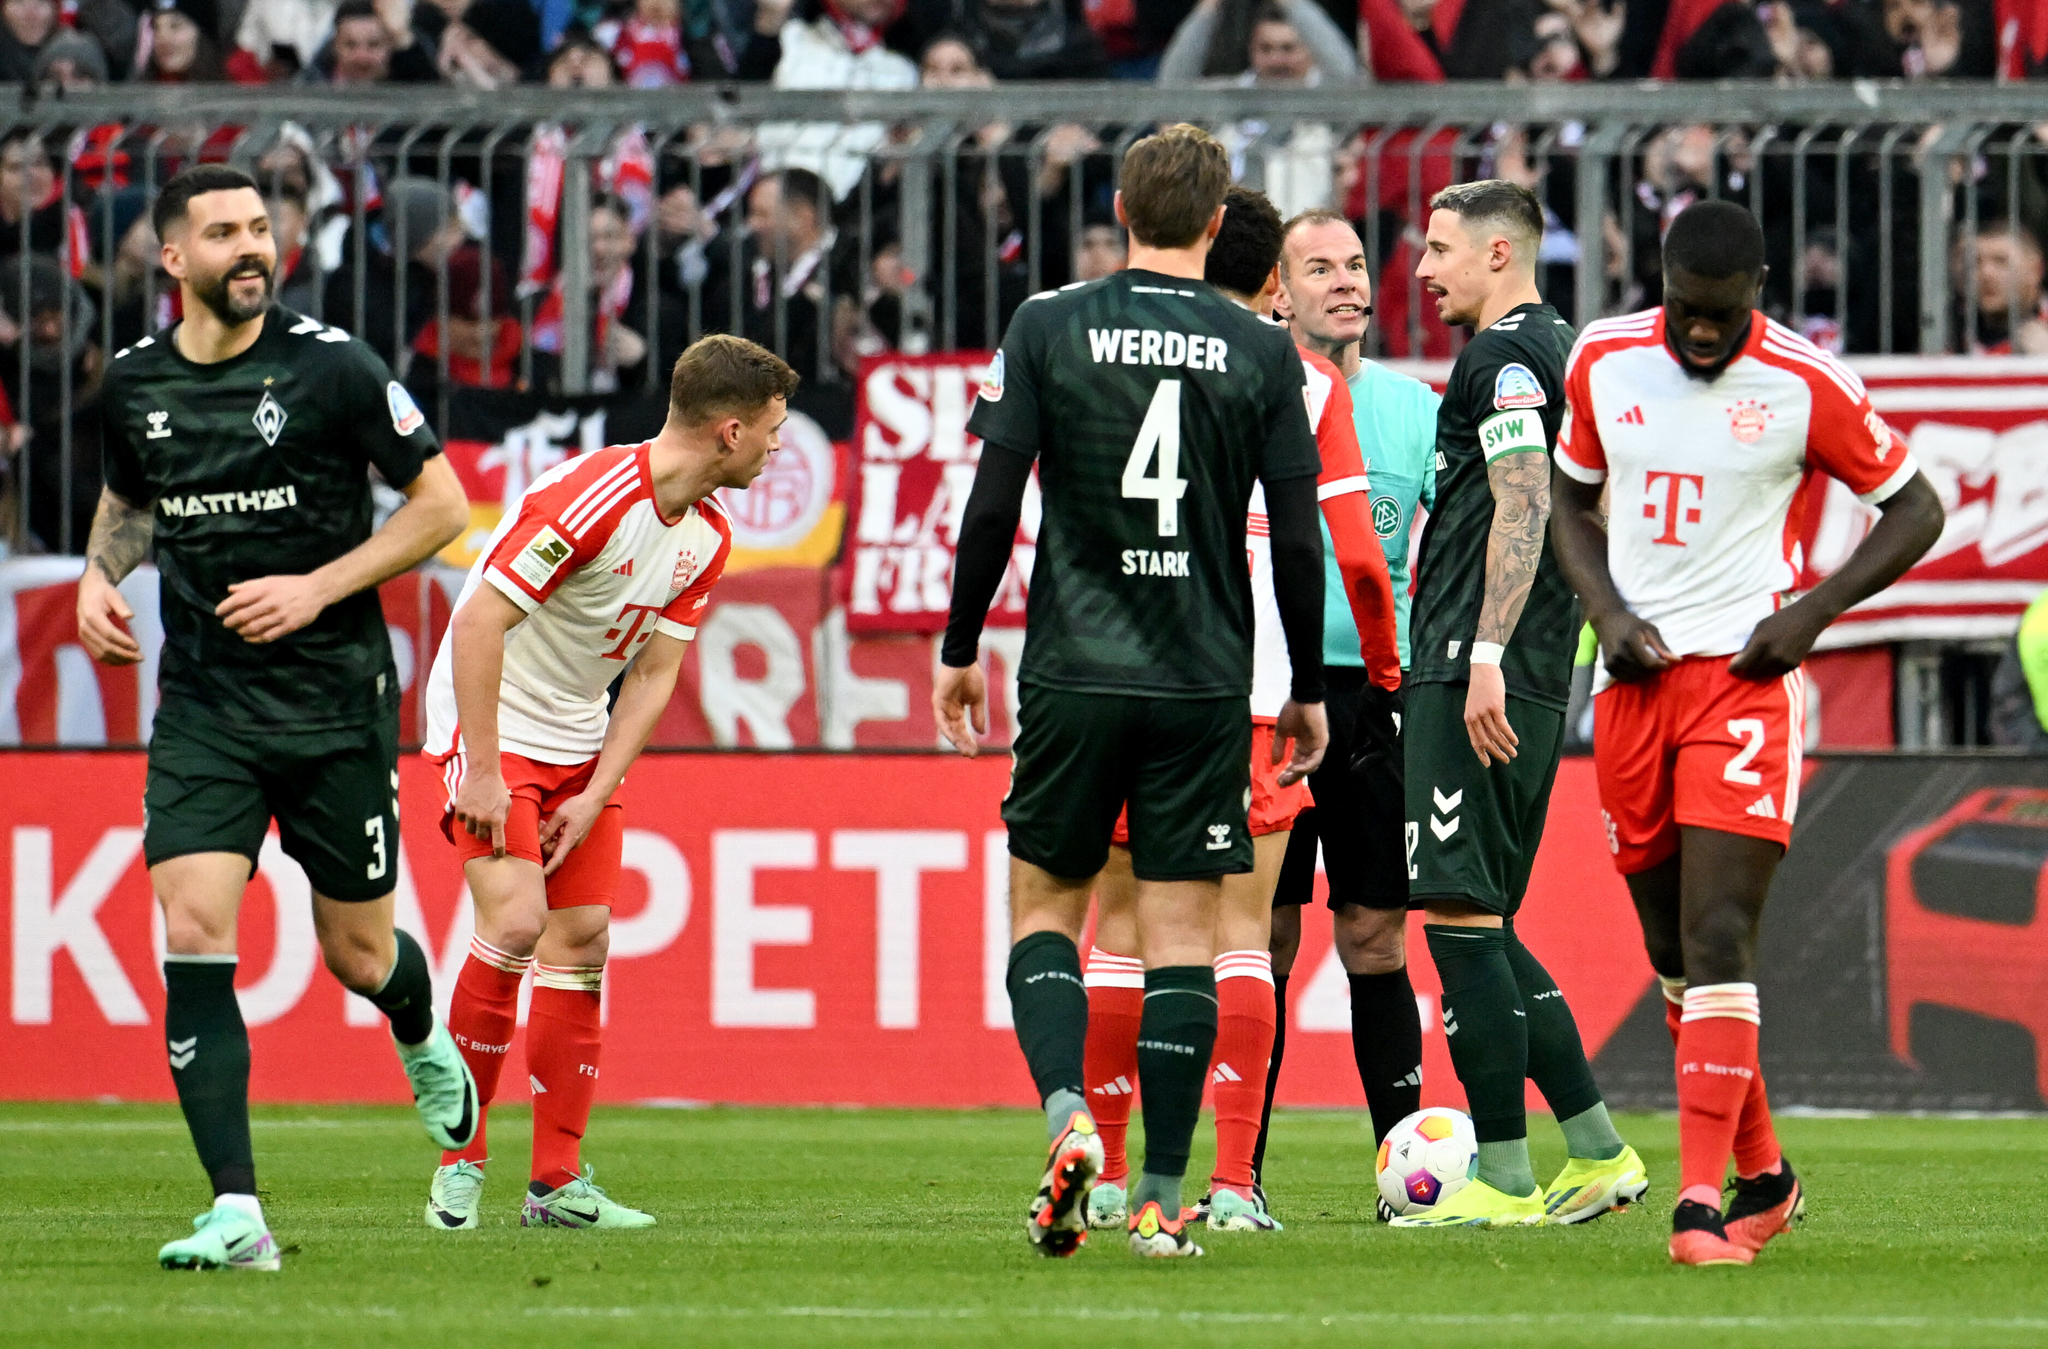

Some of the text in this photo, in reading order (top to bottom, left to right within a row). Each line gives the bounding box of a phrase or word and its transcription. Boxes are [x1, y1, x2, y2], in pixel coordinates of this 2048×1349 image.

[1088, 328, 1228, 373] WERDER
[1485, 418, 1524, 448] SVW
[1121, 379, 1189, 537] 4
[160, 484, 297, 517] MATTHÄI
[524, 550, 552, 574] BUNDESLIGA
[1121, 549, 1190, 577] STARK
[1723, 718, 1766, 787] 2
[365, 815, 388, 881] 3
[455, 1033, 468, 1047] FC
[578, 1063, 594, 1077] FC
